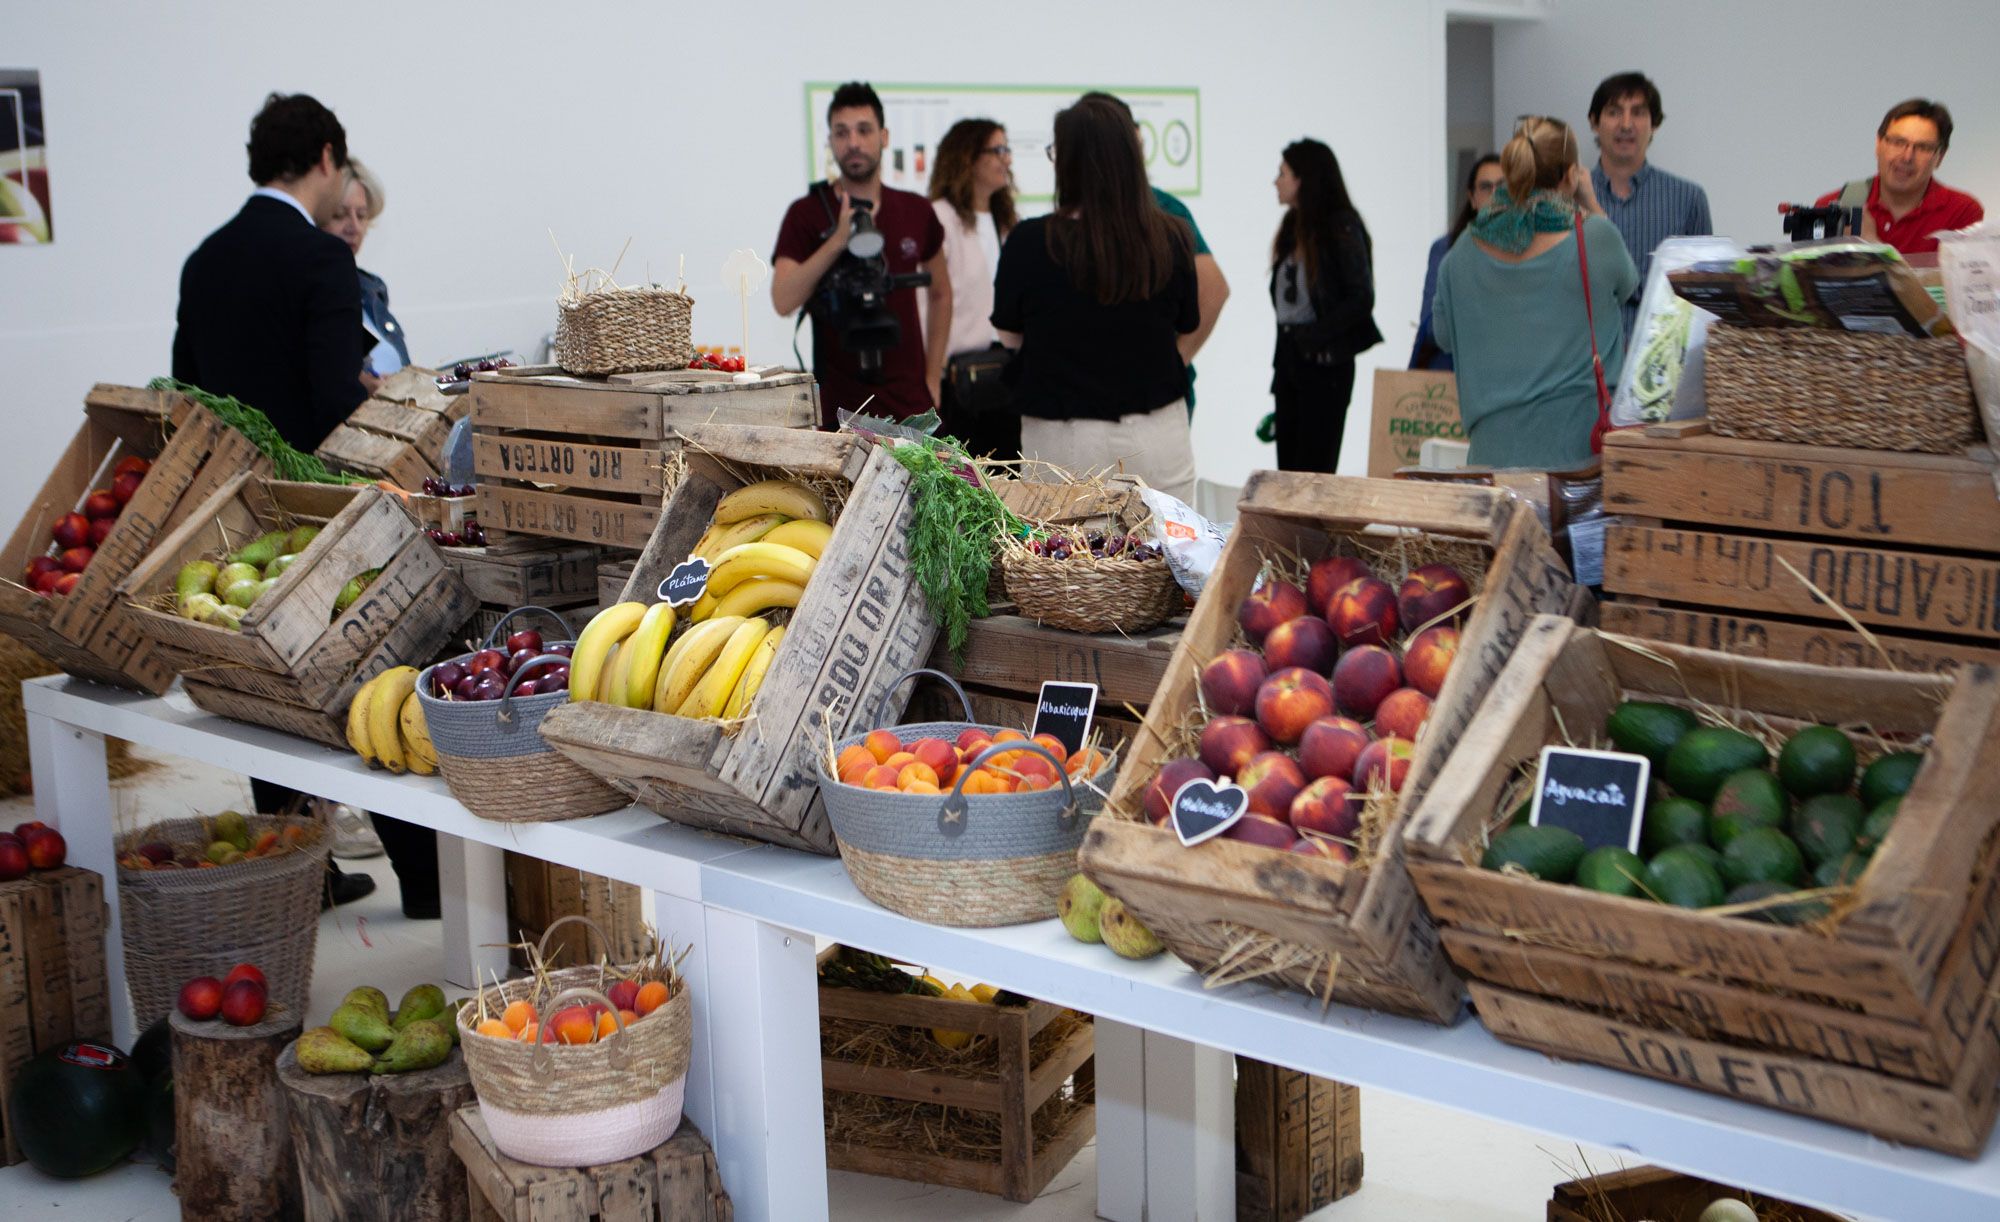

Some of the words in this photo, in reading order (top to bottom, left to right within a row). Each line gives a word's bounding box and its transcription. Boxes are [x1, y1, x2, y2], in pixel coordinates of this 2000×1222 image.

[1389, 416, 1466, 438] FRESCO
[499, 443, 575, 475] ORTEGA
[583, 447, 622, 480] RIC.
[501, 500, 578, 535] ORTEGA
